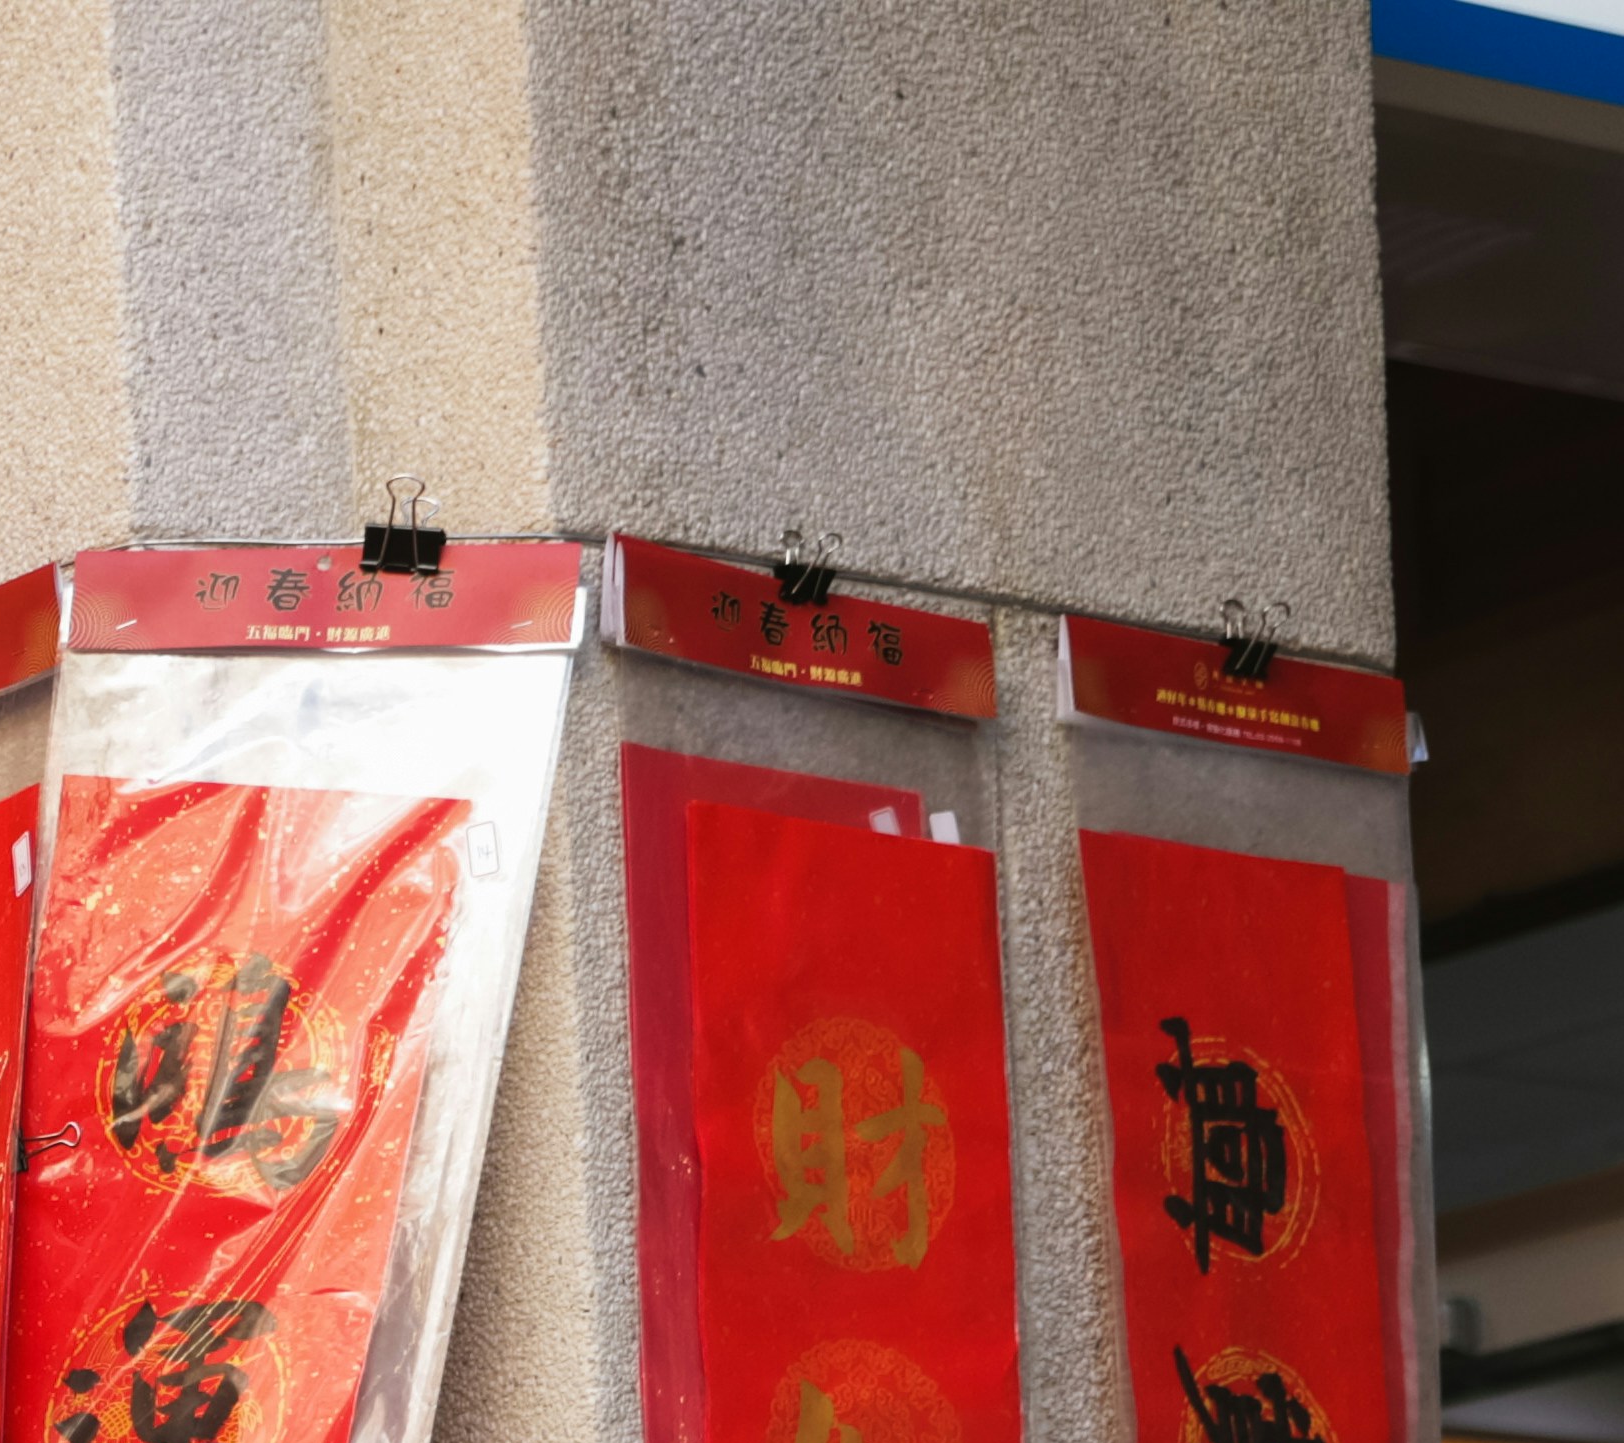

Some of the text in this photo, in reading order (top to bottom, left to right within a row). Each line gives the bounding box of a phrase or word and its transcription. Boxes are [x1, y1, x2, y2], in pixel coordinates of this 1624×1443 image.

[195, 567, 456, 612] 迎春納福
[710, 590, 904, 666] 迎春納福
